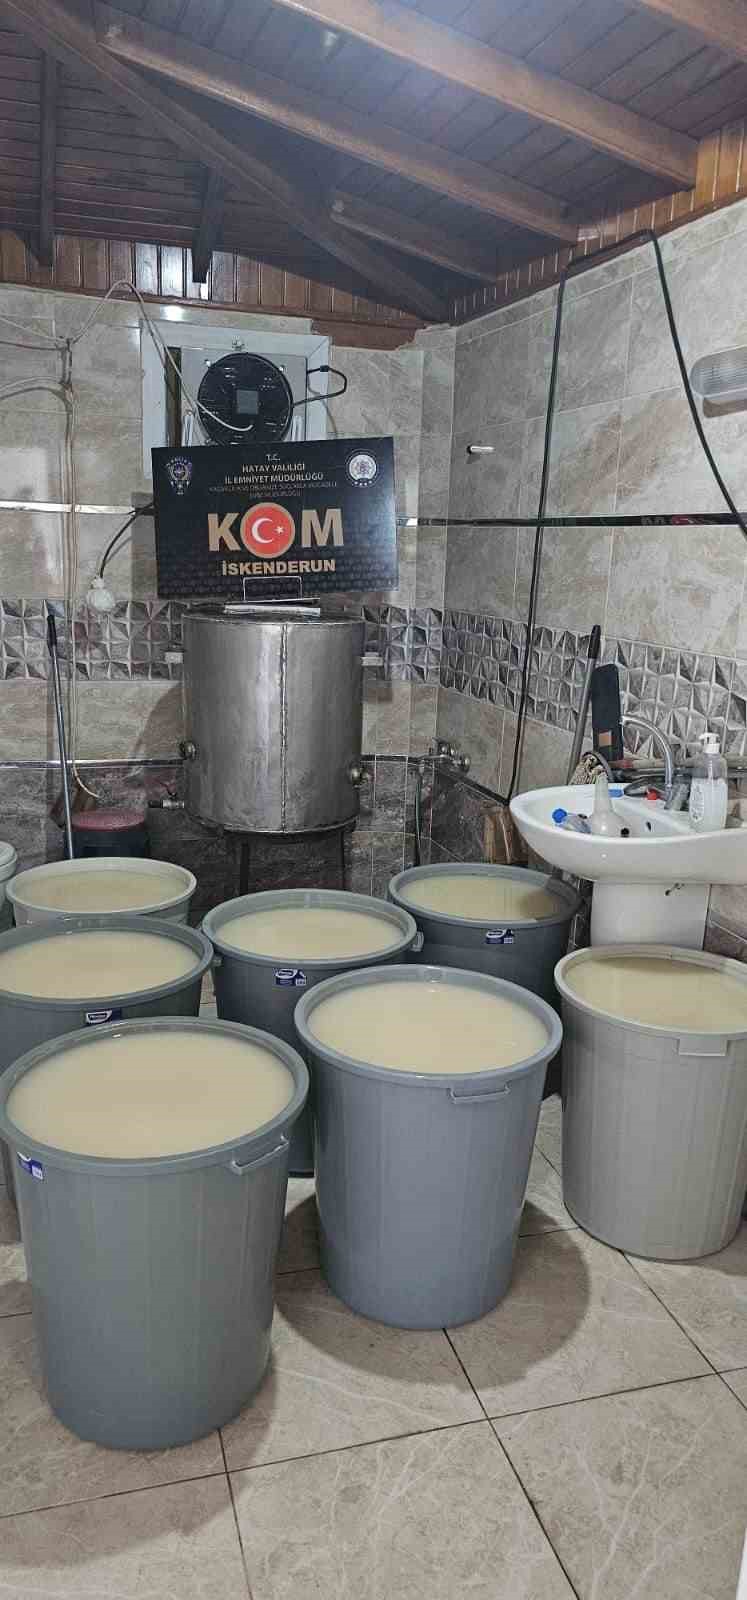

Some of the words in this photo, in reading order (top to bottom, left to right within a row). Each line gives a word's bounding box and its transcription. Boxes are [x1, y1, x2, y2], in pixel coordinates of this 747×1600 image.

[266, 453, 281, 461] T.C.
[242, 463, 270, 473] HATAY
[222, 559, 336, 576] İSKENDERUN
